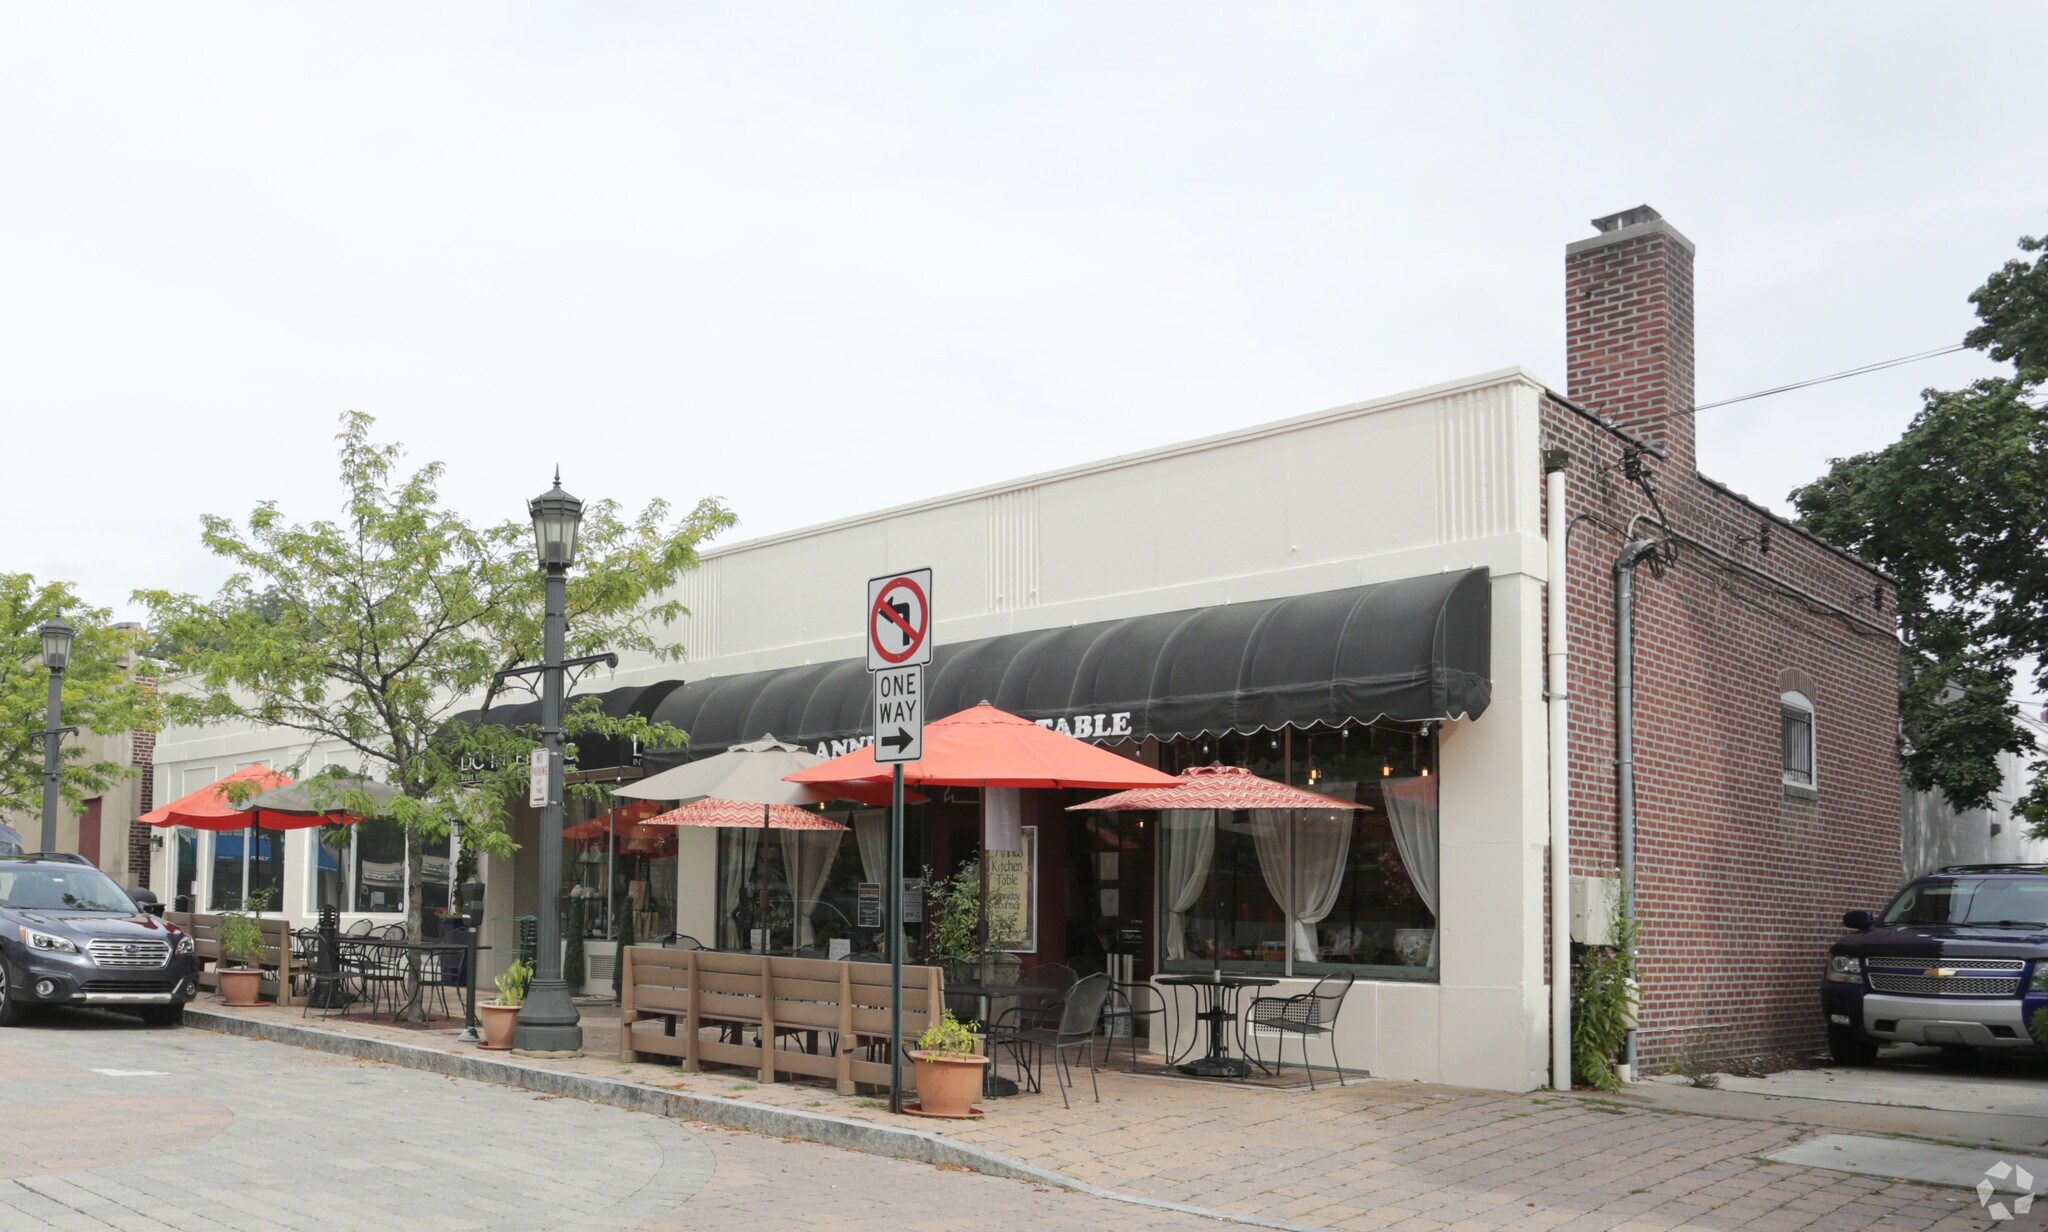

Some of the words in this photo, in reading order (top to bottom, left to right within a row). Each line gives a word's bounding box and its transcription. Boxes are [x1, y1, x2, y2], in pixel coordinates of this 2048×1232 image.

[881, 673, 916, 697] ONE
[880, 700, 917, 724] WAY
[536, 753, 543, 764] NO
[531, 765, 548, 776] PARKING
[991, 859, 1023, 872] Kitchen
[996, 873, 1019, 886] Table
